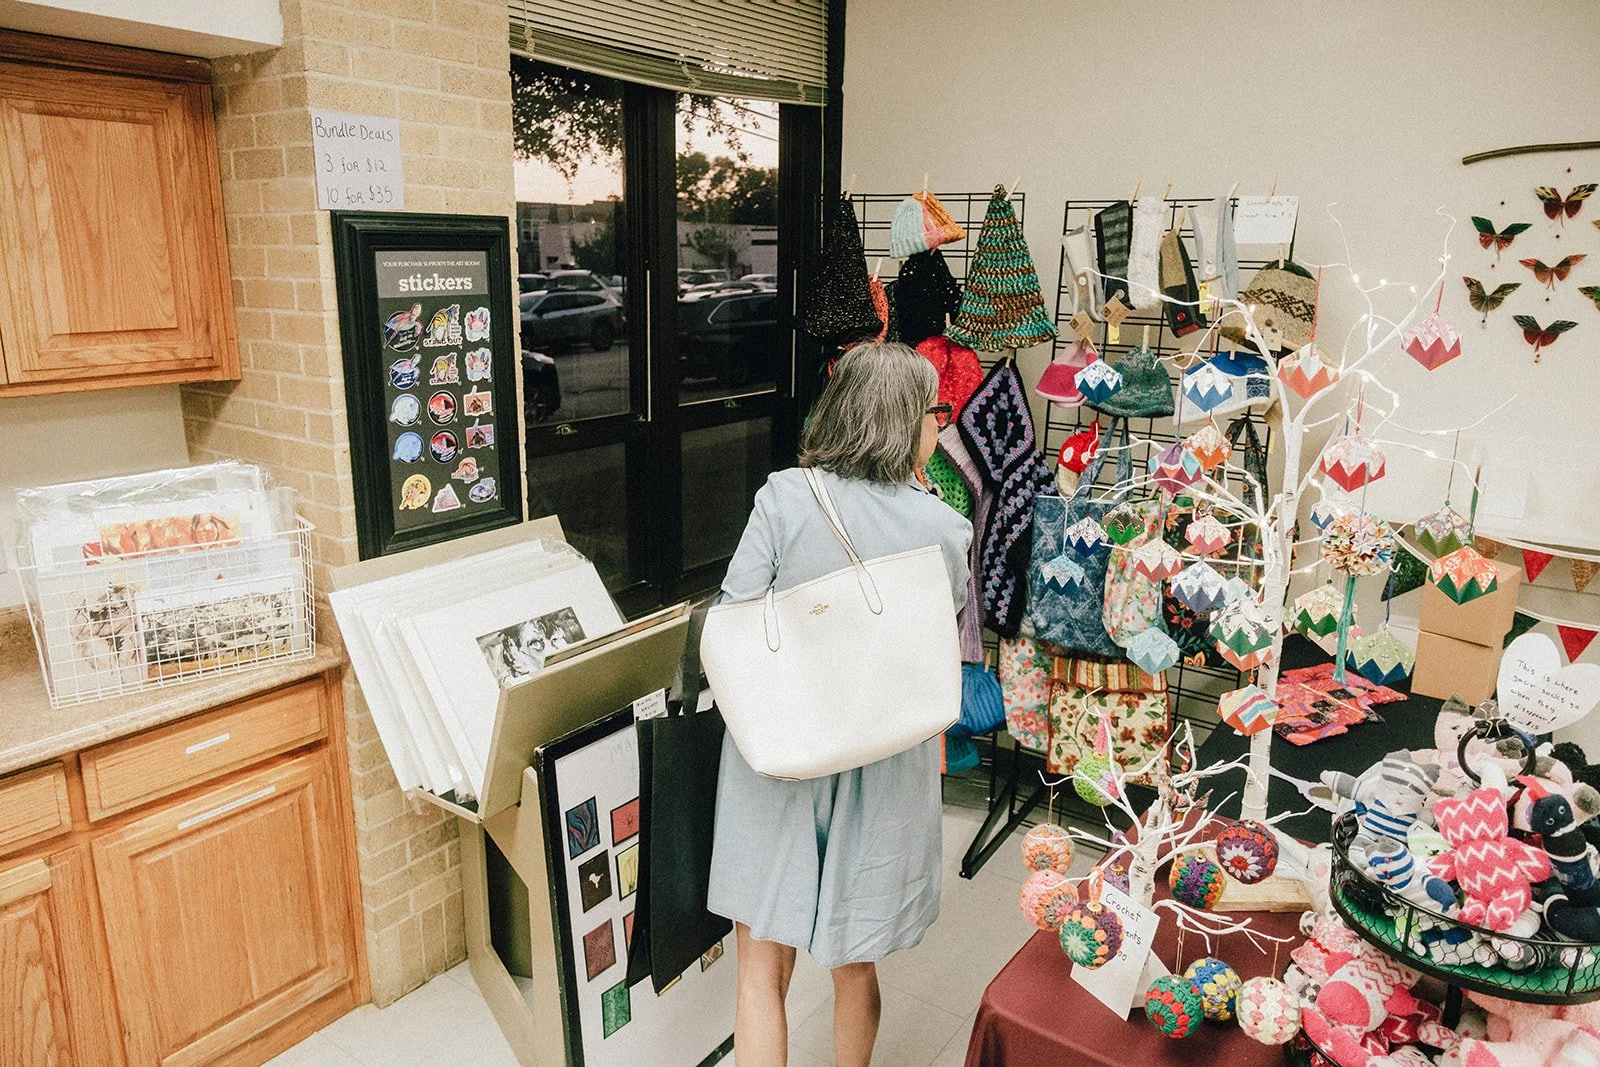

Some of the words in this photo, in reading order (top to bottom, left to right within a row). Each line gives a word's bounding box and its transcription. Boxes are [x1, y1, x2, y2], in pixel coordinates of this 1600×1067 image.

[315, 116, 356, 138] Bundle
[360, 124, 394, 142] Deals
[324, 153, 334, 173] 3
[366, 158, 388, 173] $12
[326, 186, 340, 205] 10
[369, 185, 394, 204] $35
[398, 273, 473, 292] stickers
[1513, 675, 1536, 689] your
[1541, 688, 1565, 703] socks
[1517, 659, 1535, 676] This
[1543, 673, 1551, 682] is
[1554, 680, 1578, 696] where
[1510, 688, 1531, 701] when
[1105, 893, 1142, 922] Crochet
